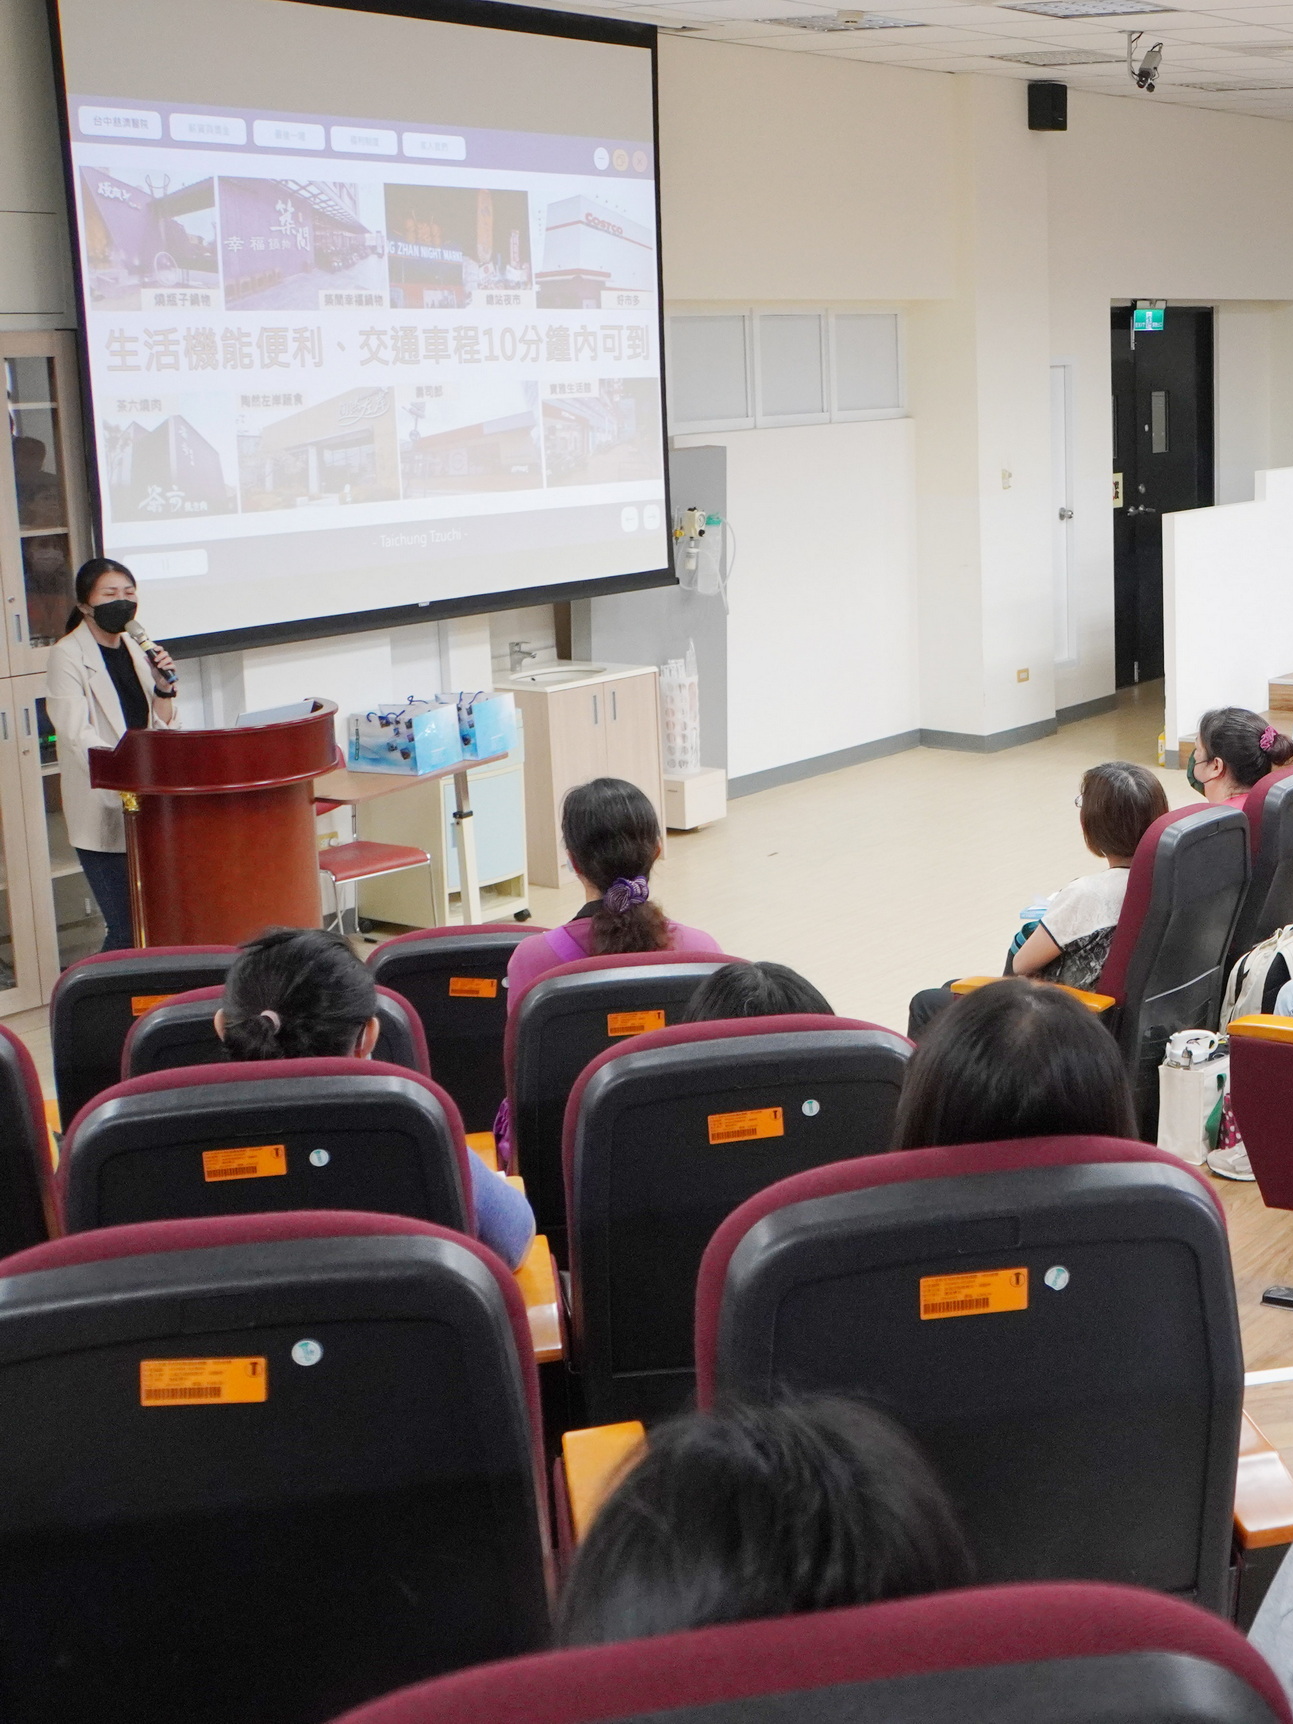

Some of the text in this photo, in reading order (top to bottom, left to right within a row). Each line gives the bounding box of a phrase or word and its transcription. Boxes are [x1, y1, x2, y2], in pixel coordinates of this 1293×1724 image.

[93, 116, 149, 129] 台中慈濟醫院
[585, 212, 623, 235] COSTCO
[397, 241, 420, 257] ZHAN
[421, 245, 442, 260] NIGHT
[616, 294, 640, 306] 好市多
[380, 532, 428, 548] Taichung
[430, 528, 462, 542] Tzuchi
